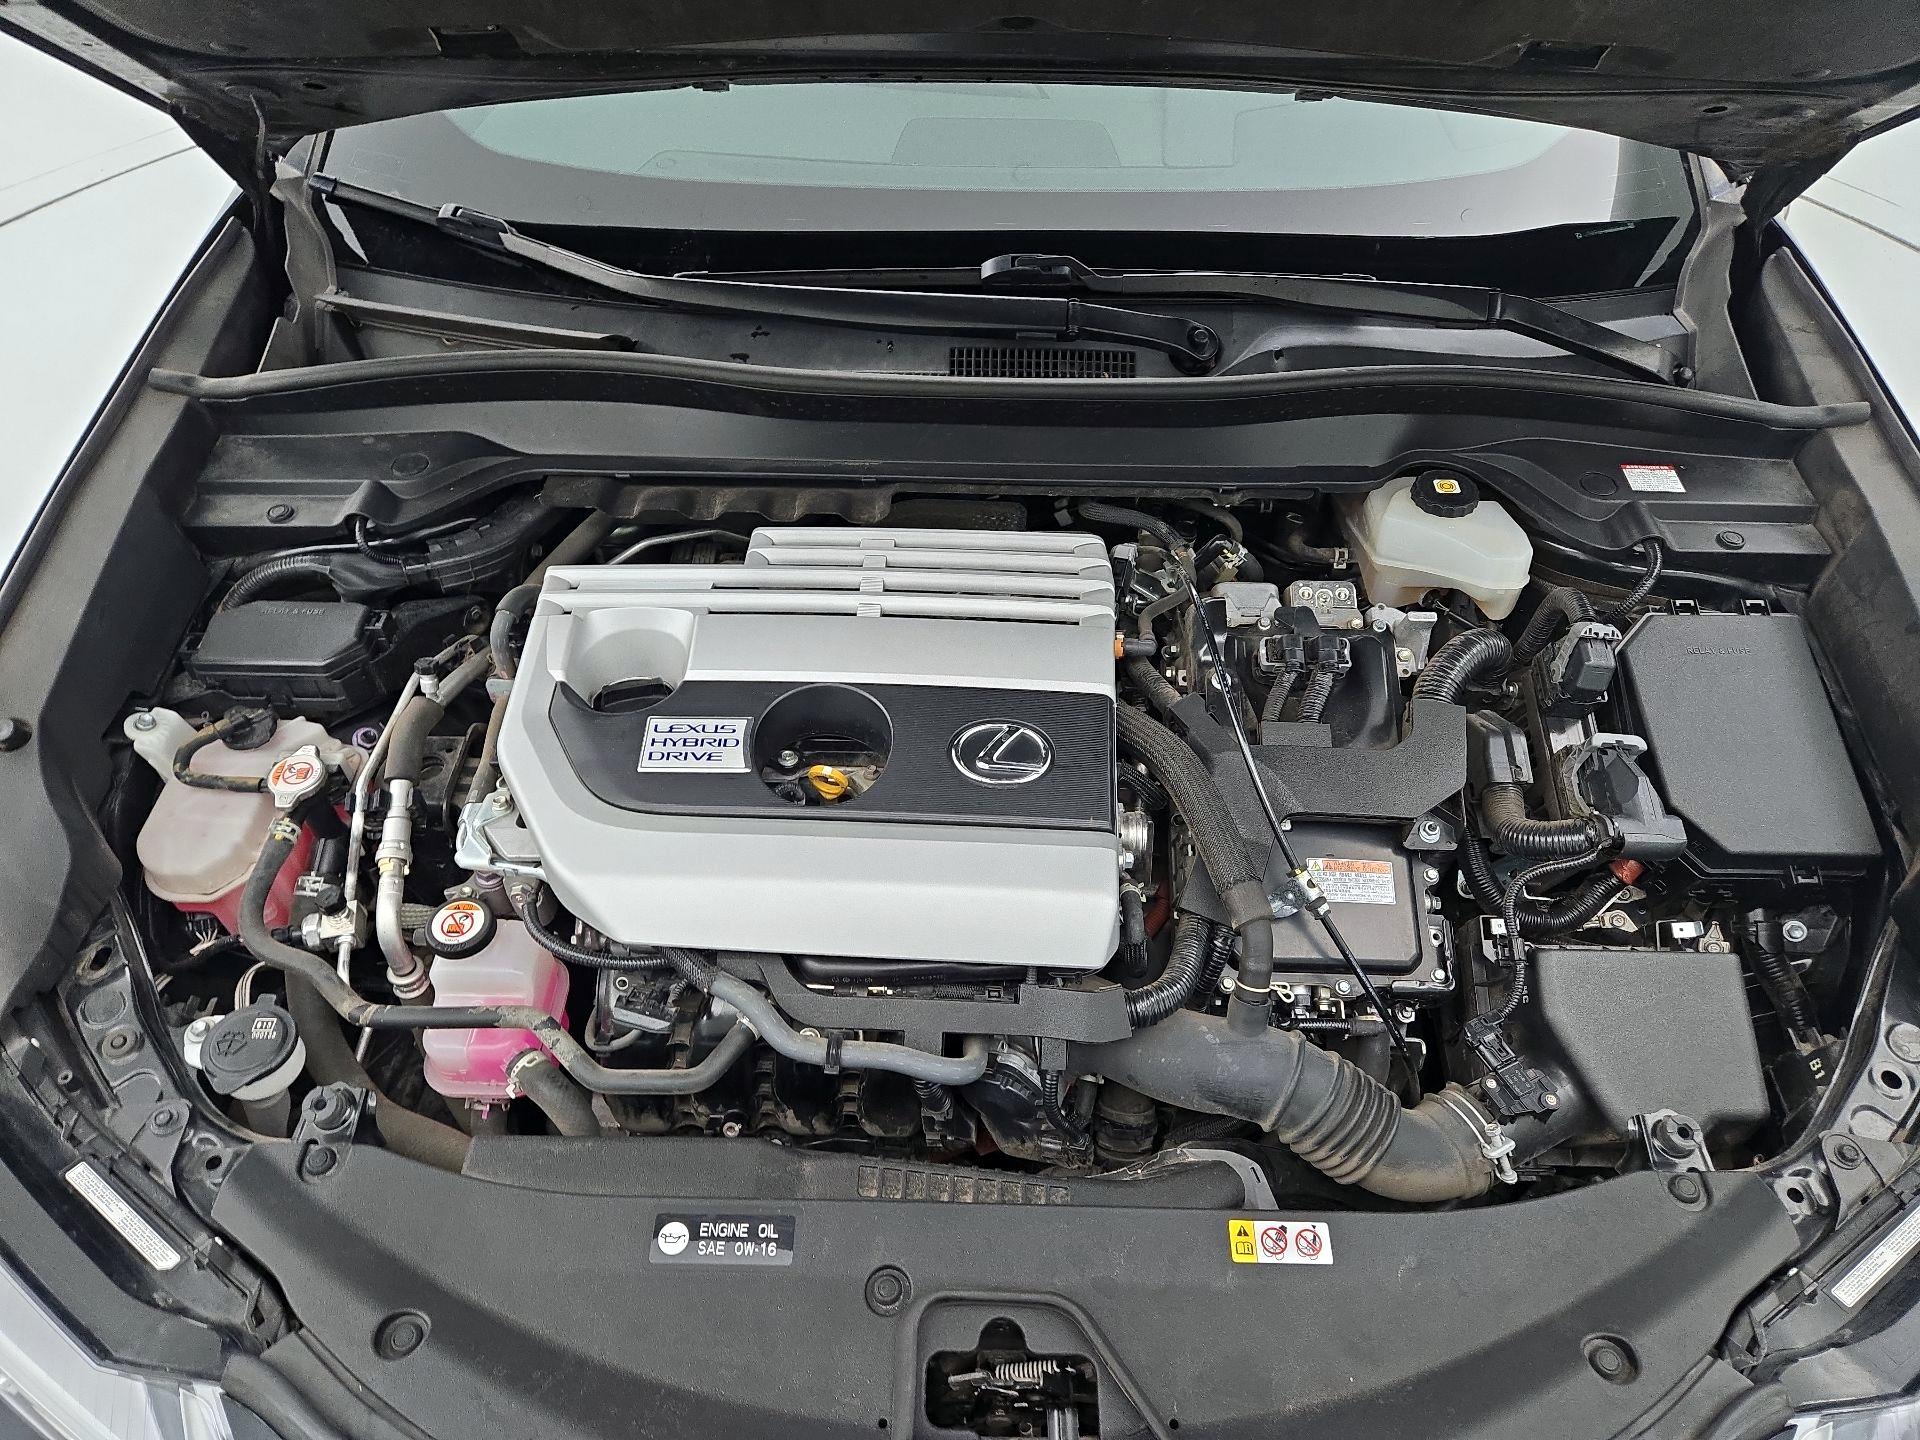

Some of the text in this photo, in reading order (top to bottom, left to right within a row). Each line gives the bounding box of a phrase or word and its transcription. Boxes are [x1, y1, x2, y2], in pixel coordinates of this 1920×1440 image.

[653, 723, 737, 734] LEXUS
[650, 737, 740, 748] HYBRID
[647, 751, 724, 762] DRIVE
[1809, 1057, 1826, 1080] B1
[699, 1222, 779, 1239] ENGINE OIL
[697, 1240, 777, 1257] SAE 0W-16
